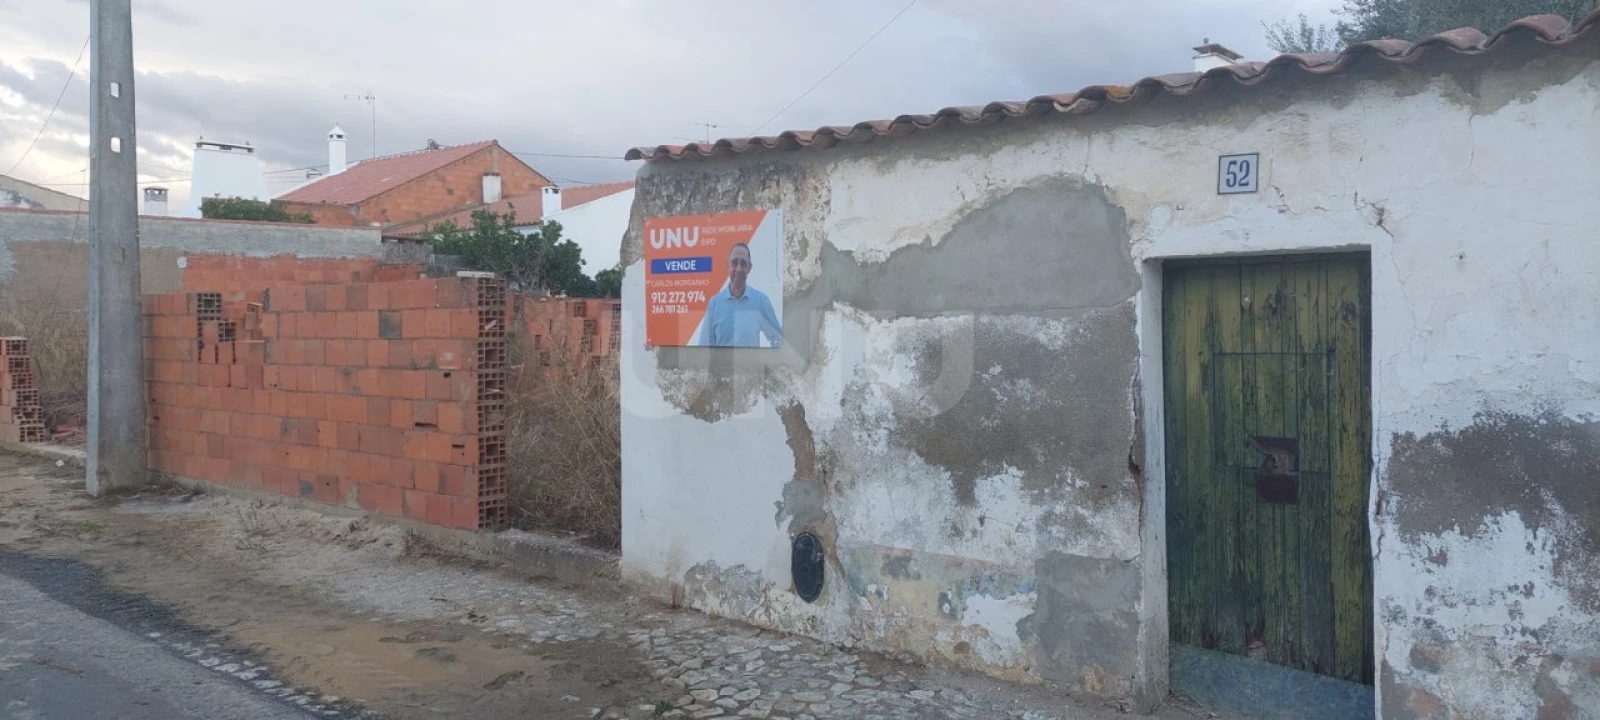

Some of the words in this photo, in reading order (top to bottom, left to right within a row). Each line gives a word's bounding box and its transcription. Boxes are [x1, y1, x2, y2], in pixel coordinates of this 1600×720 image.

[1226, 160, 1250, 188] 52
[650, 226, 699, 250] UNU
[664, 259, 697, 271] VENDE
[650, 279, 673, 287] CARLOS
[651, 291, 667, 304] 912
[668, 291, 686, 304] 272
[687, 290, 706, 303] 974
